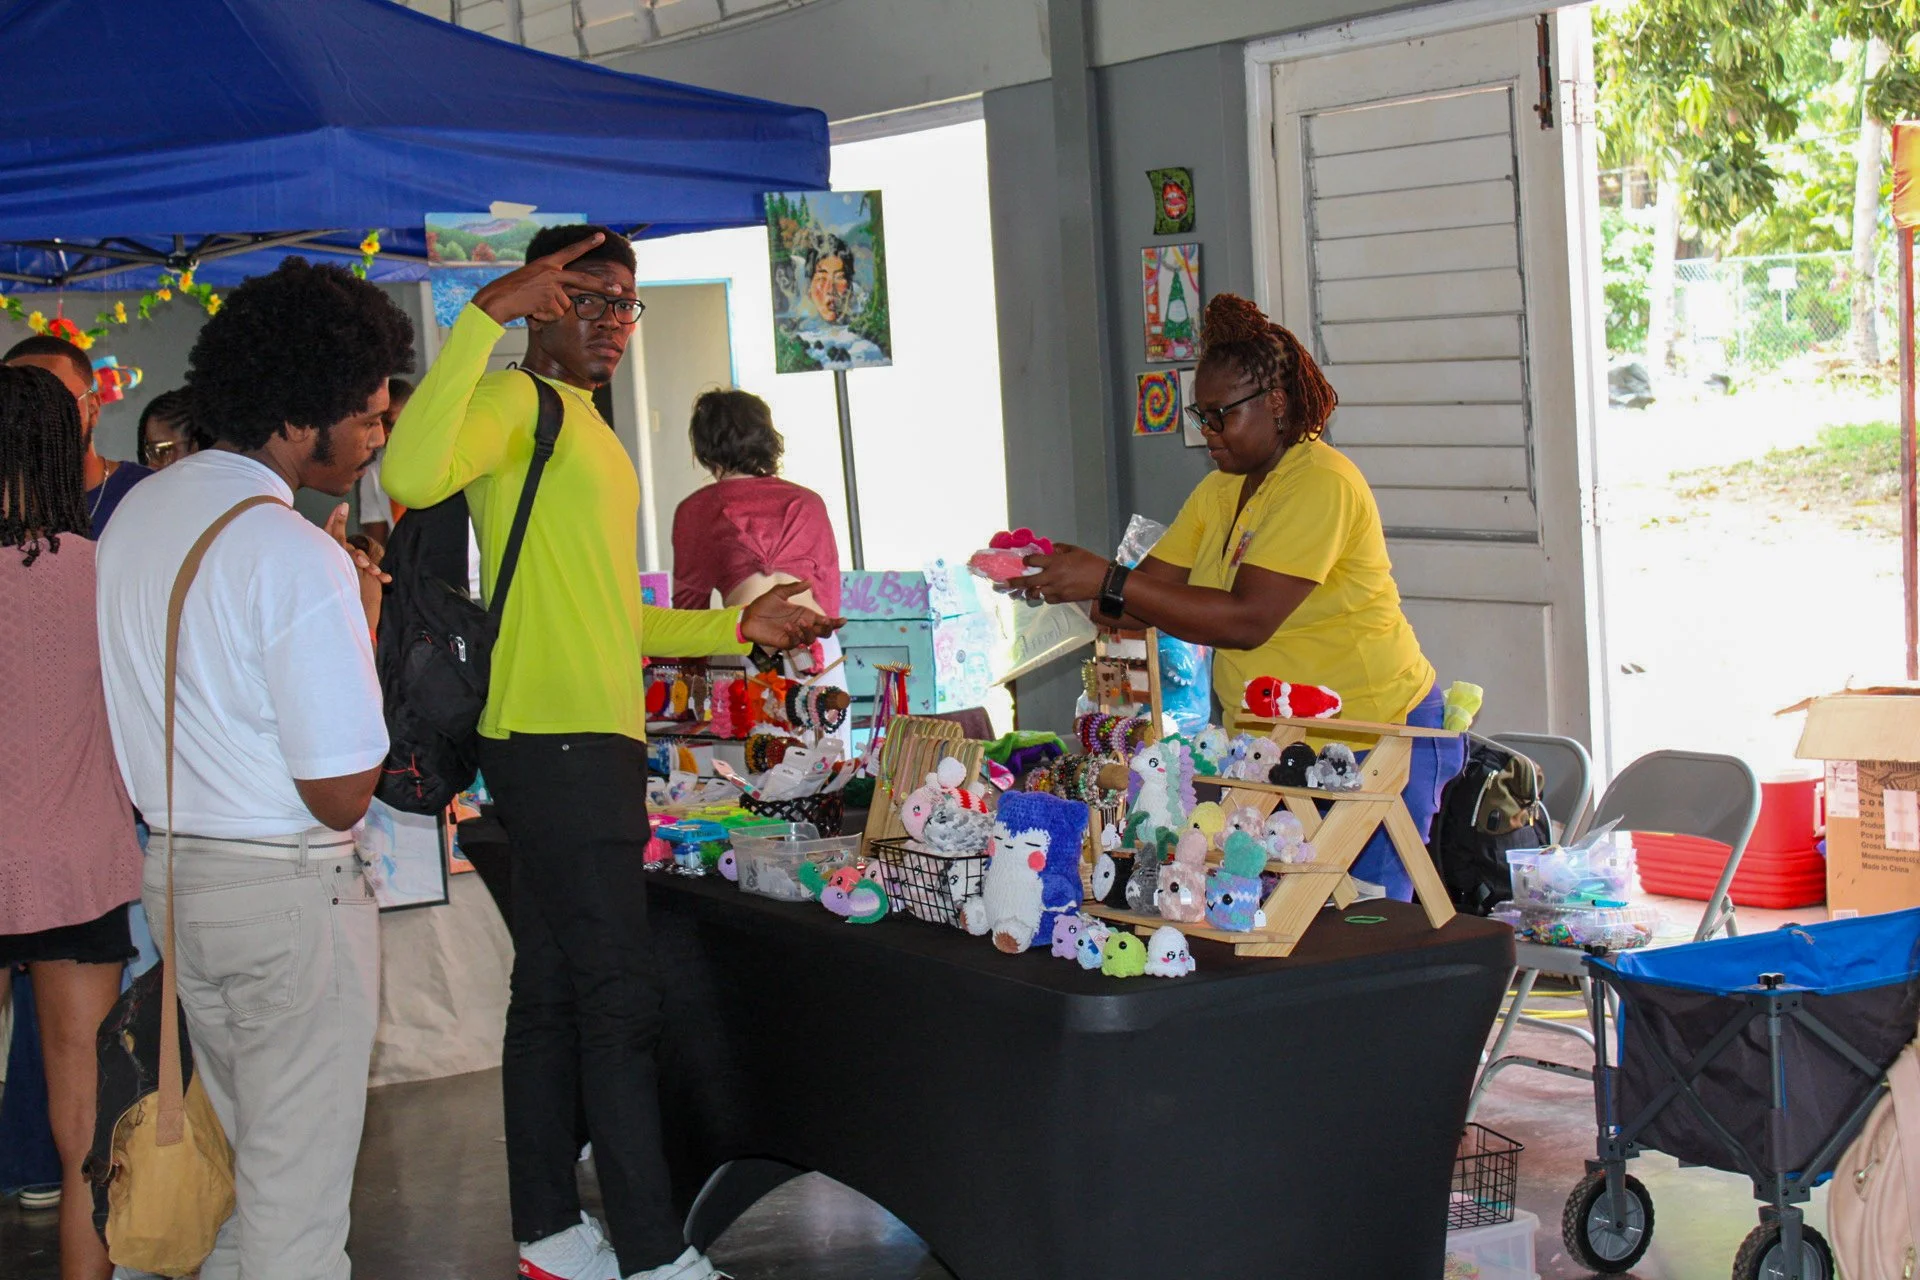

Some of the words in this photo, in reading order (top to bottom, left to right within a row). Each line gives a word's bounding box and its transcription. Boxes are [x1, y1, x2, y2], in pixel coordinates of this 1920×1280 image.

[1861, 841, 1881, 850] Gross
[1861, 862, 1880, 870] Made
[1889, 865, 1910, 873] China
